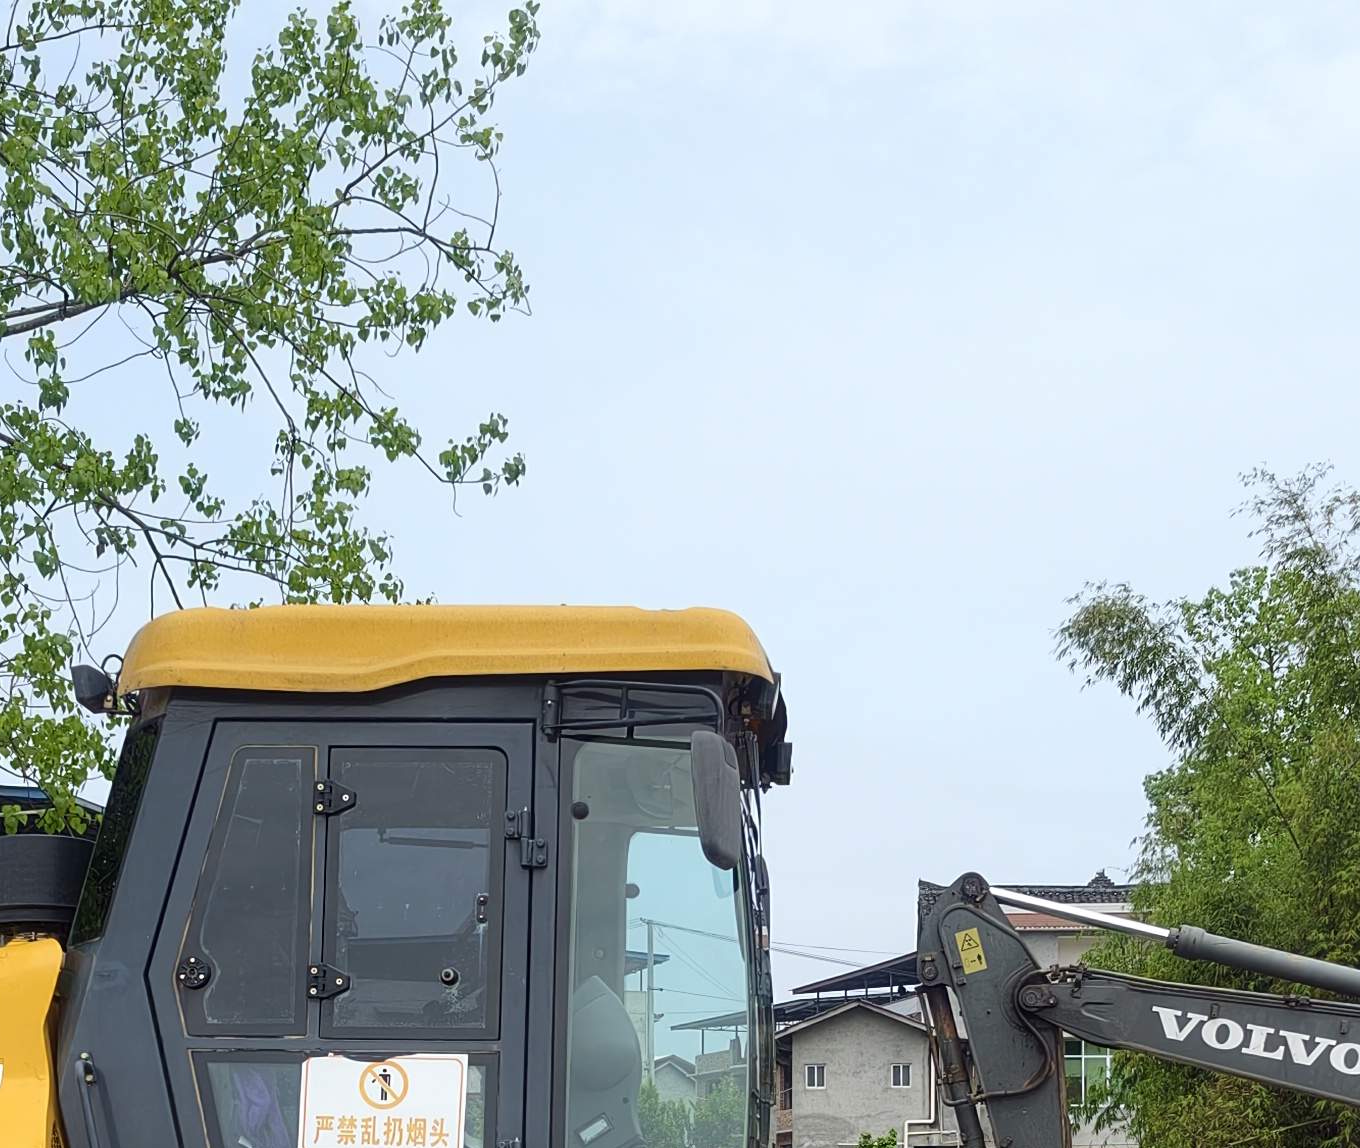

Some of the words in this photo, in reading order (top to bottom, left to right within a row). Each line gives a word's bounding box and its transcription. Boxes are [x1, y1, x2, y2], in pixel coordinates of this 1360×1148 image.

[313, 1115, 450, 1148] 严禁乱扔烟头
